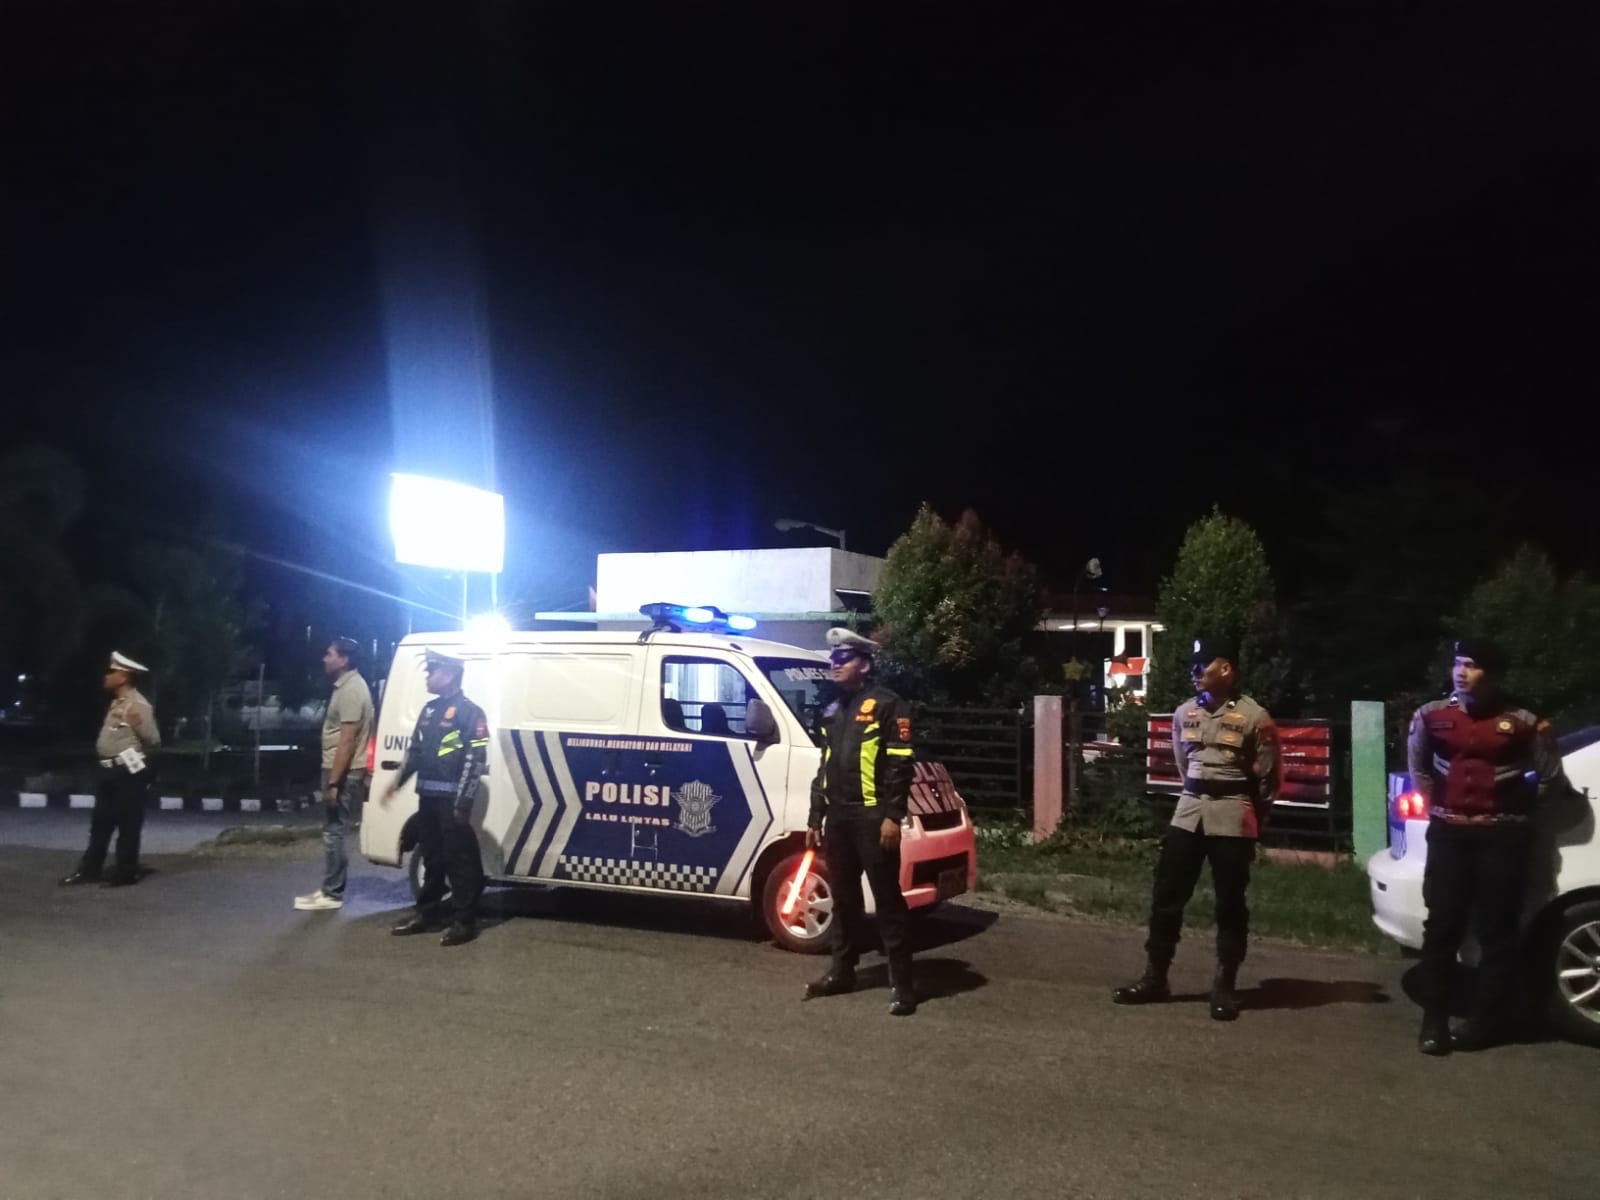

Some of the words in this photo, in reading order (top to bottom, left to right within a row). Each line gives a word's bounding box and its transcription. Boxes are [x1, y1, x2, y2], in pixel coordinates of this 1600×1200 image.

[384, 734, 411, 750] UNI
[585, 781, 670, 807] POLISI
[585, 812, 618, 823] LALU
[620, 815, 670, 827] LINTAS
